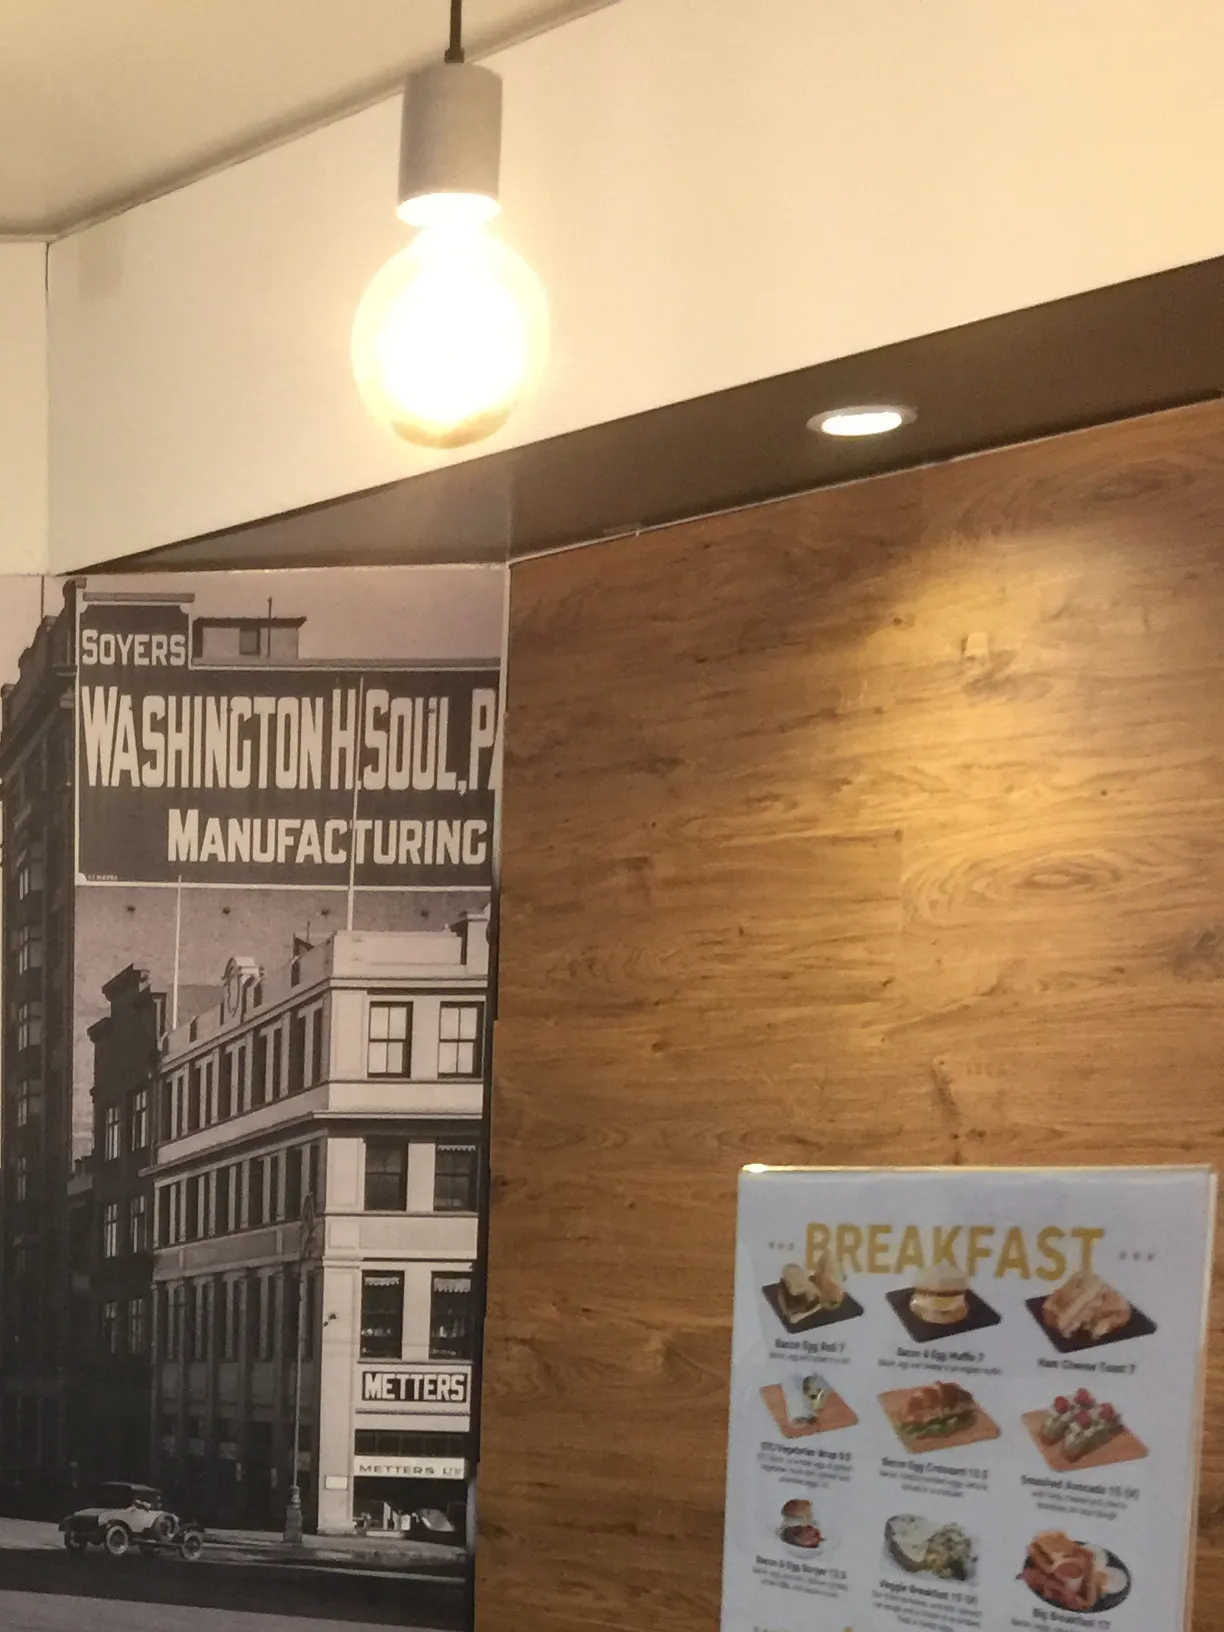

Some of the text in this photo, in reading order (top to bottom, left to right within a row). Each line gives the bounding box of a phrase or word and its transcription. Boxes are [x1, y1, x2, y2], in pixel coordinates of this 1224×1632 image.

[81, 629, 185, 666] SOYERS
[81, 686, 324, 789] WASHINGTON
[470, 688, 503, 791] P
[168, 808, 488, 866] MANUFACTURING
[805, 1221, 1104, 1282] BREAKFAST
[364, 1374, 464, 1401] METTERS
